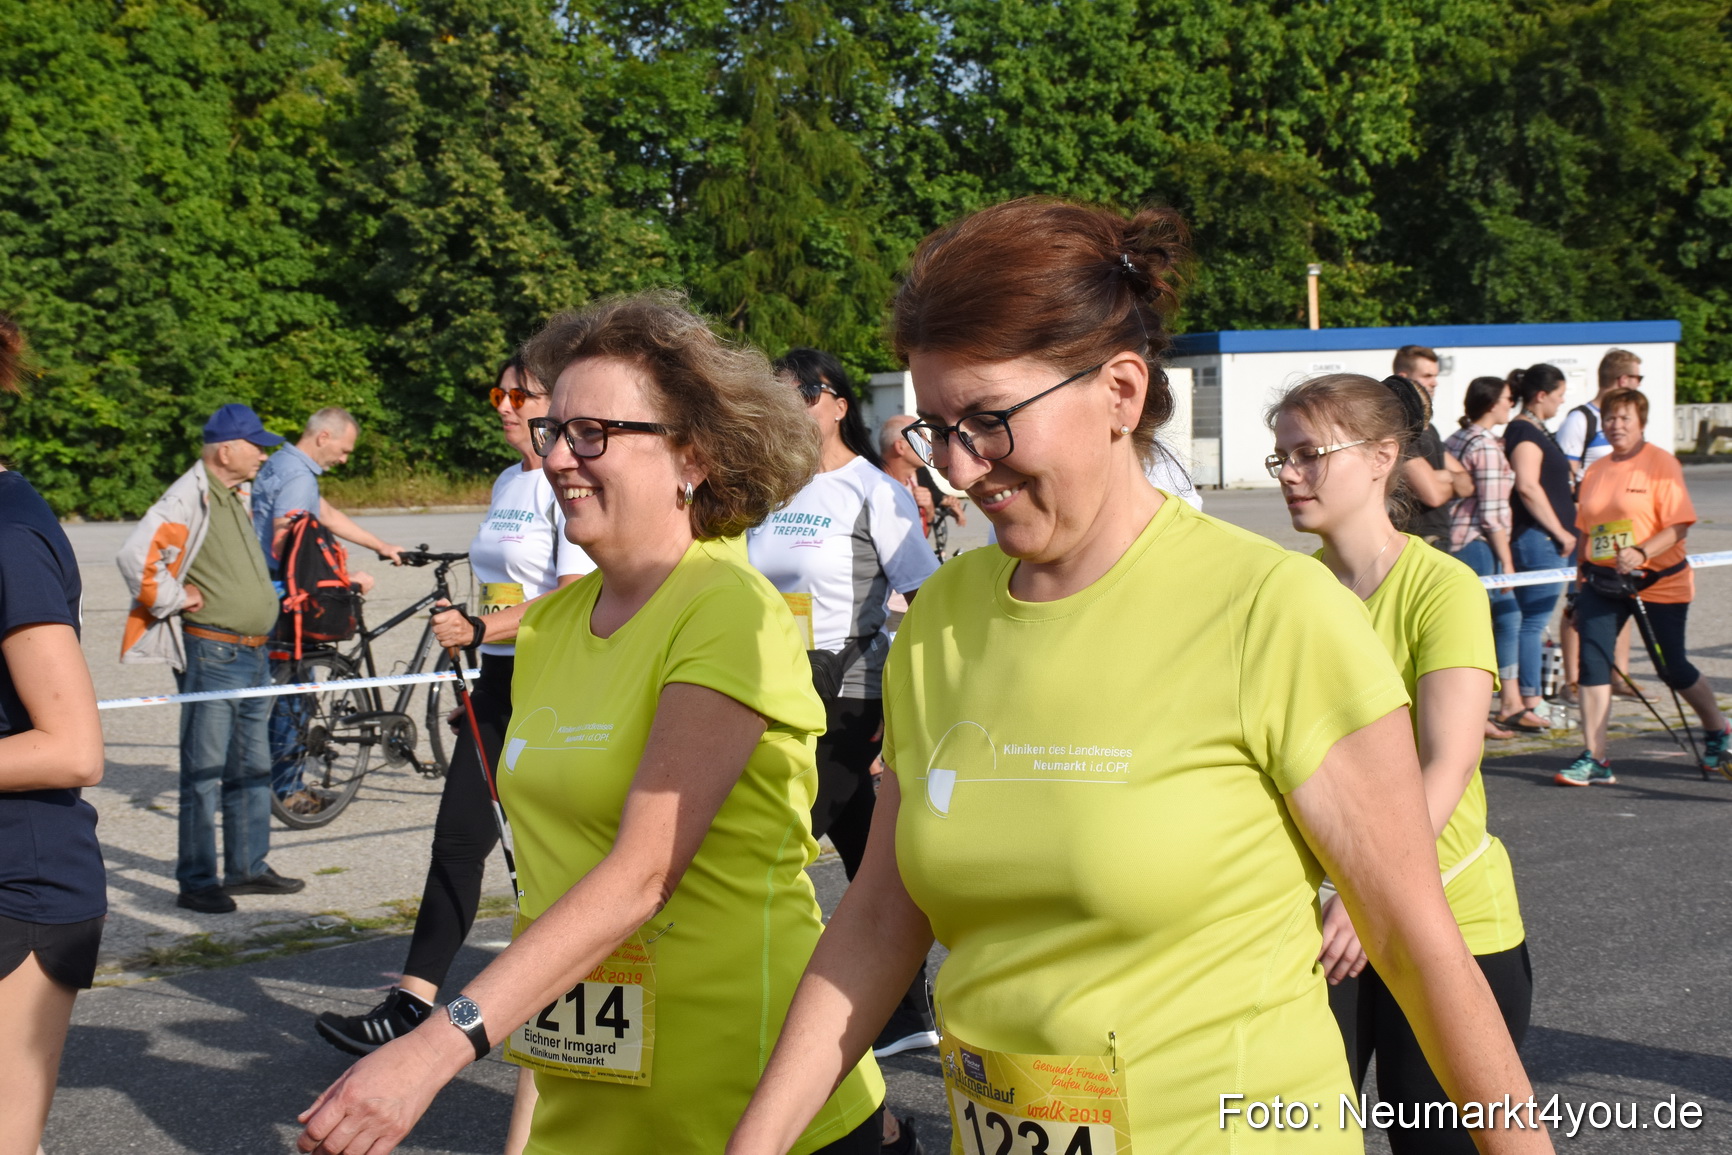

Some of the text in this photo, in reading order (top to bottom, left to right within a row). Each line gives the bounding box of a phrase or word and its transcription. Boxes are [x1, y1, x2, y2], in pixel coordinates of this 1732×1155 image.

[491, 508, 535, 523] HAUBNER
[772, 512, 832, 529] HAUBNER
[489, 521, 522, 532] TREPPEN
[773, 525, 818, 537] TREPPEN
[1003, 743, 1133, 758] Kliniken des Landkreises
[1033, 759, 1130, 774] Neumarkt i.d.OPf.
[583, 965, 643, 985] alk 2019
[523, 982, 630, 1039] 214
[524, 1028, 617, 1056] Eichner Irmgard
[530, 1045, 560, 1061] Klinikum
[561, 1054, 605, 1067] Neumarkt
[1033, 1059, 1109, 1082] Gesunde Firmen
[957, 1067, 1015, 1104] firmenlauf
[1051, 1075, 1120, 1099] laufen länger!
[1027, 1100, 1112, 1124] walk 2019
